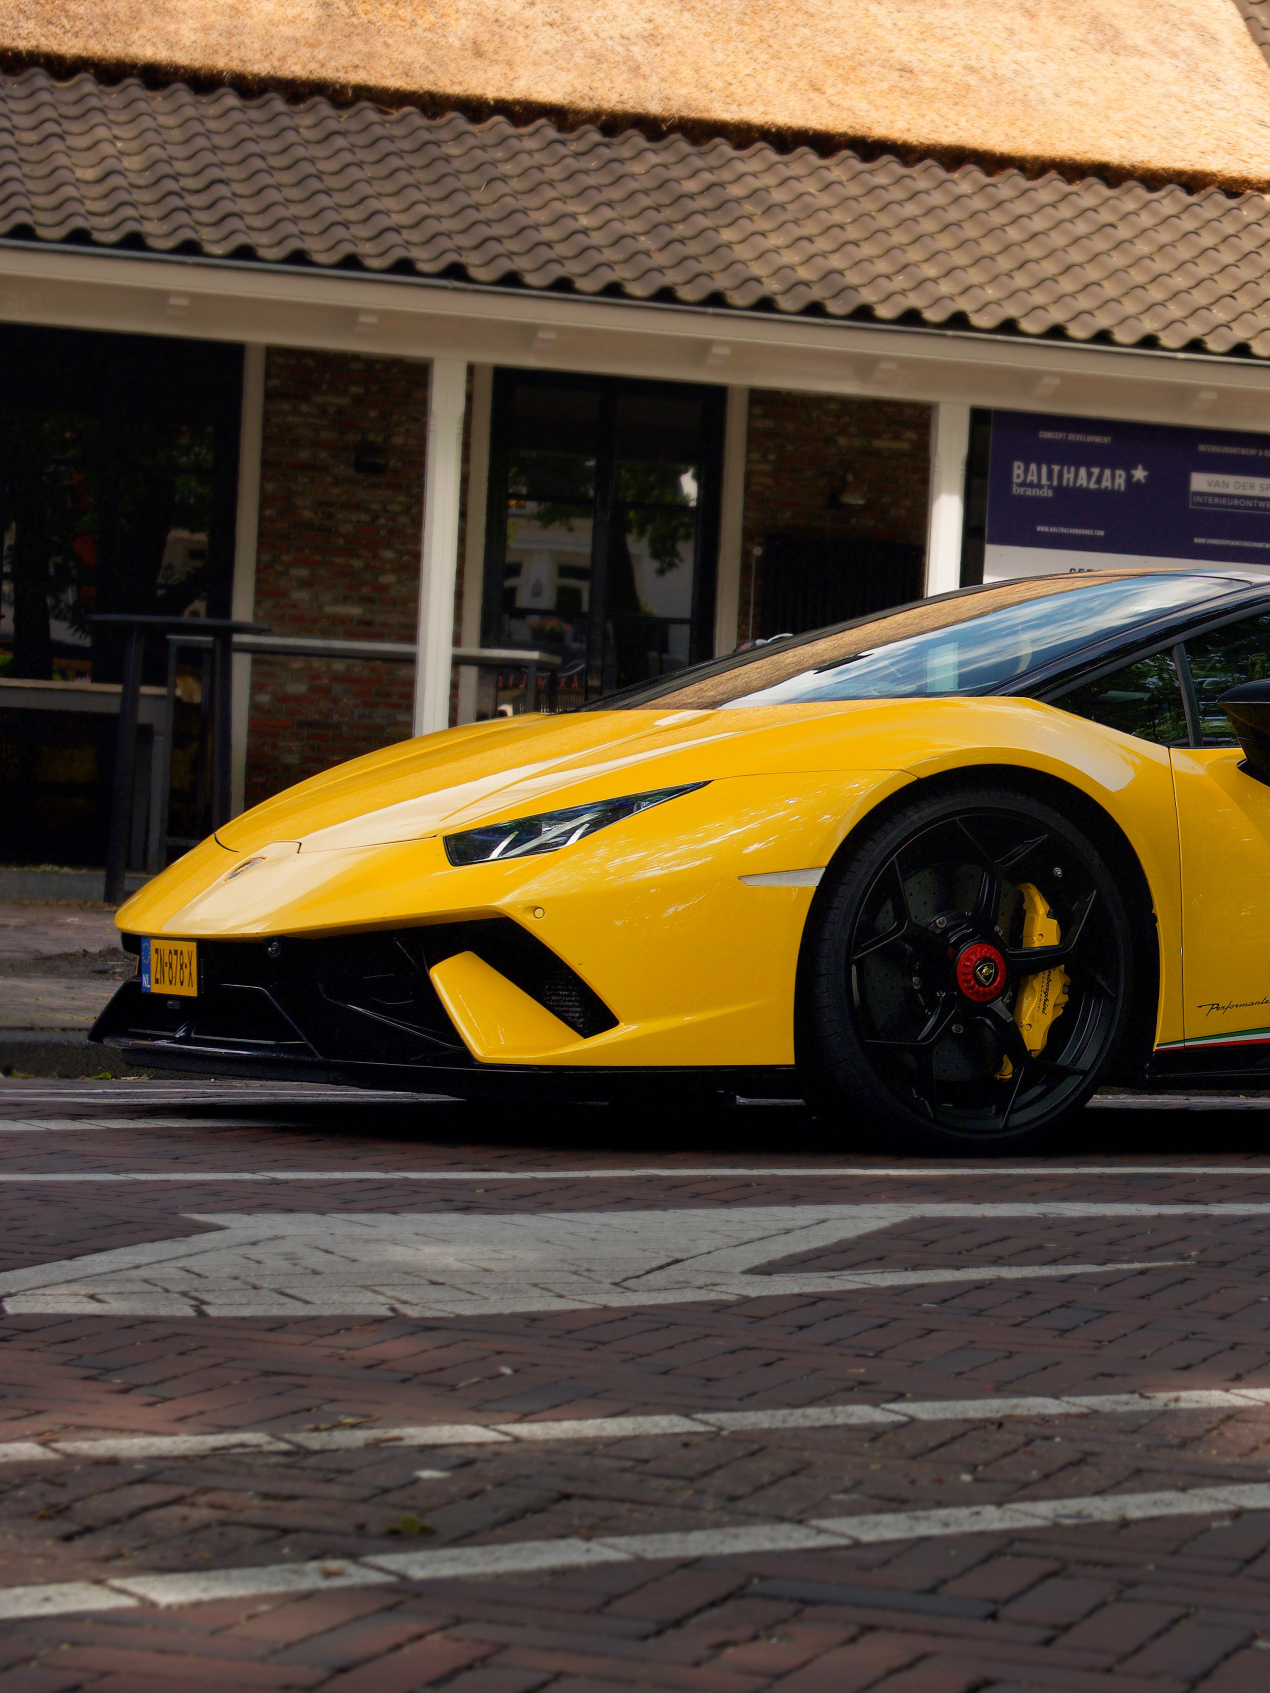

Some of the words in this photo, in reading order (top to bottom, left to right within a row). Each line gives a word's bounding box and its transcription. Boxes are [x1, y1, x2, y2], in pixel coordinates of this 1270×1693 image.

[1039, 430, 1067, 440] CONCEPT
[1067, 433, 1112, 444] DEVELOPMENT
[1012, 461, 1127, 492] BALTHAZAR
[1012, 483, 1053, 498] brands
[1207, 479, 1230, 489] VAN
[1234, 481, 1256, 491] DER
[154, 947, 194, 988] ZN-878-X
[142, 973, 151, 988] NL
